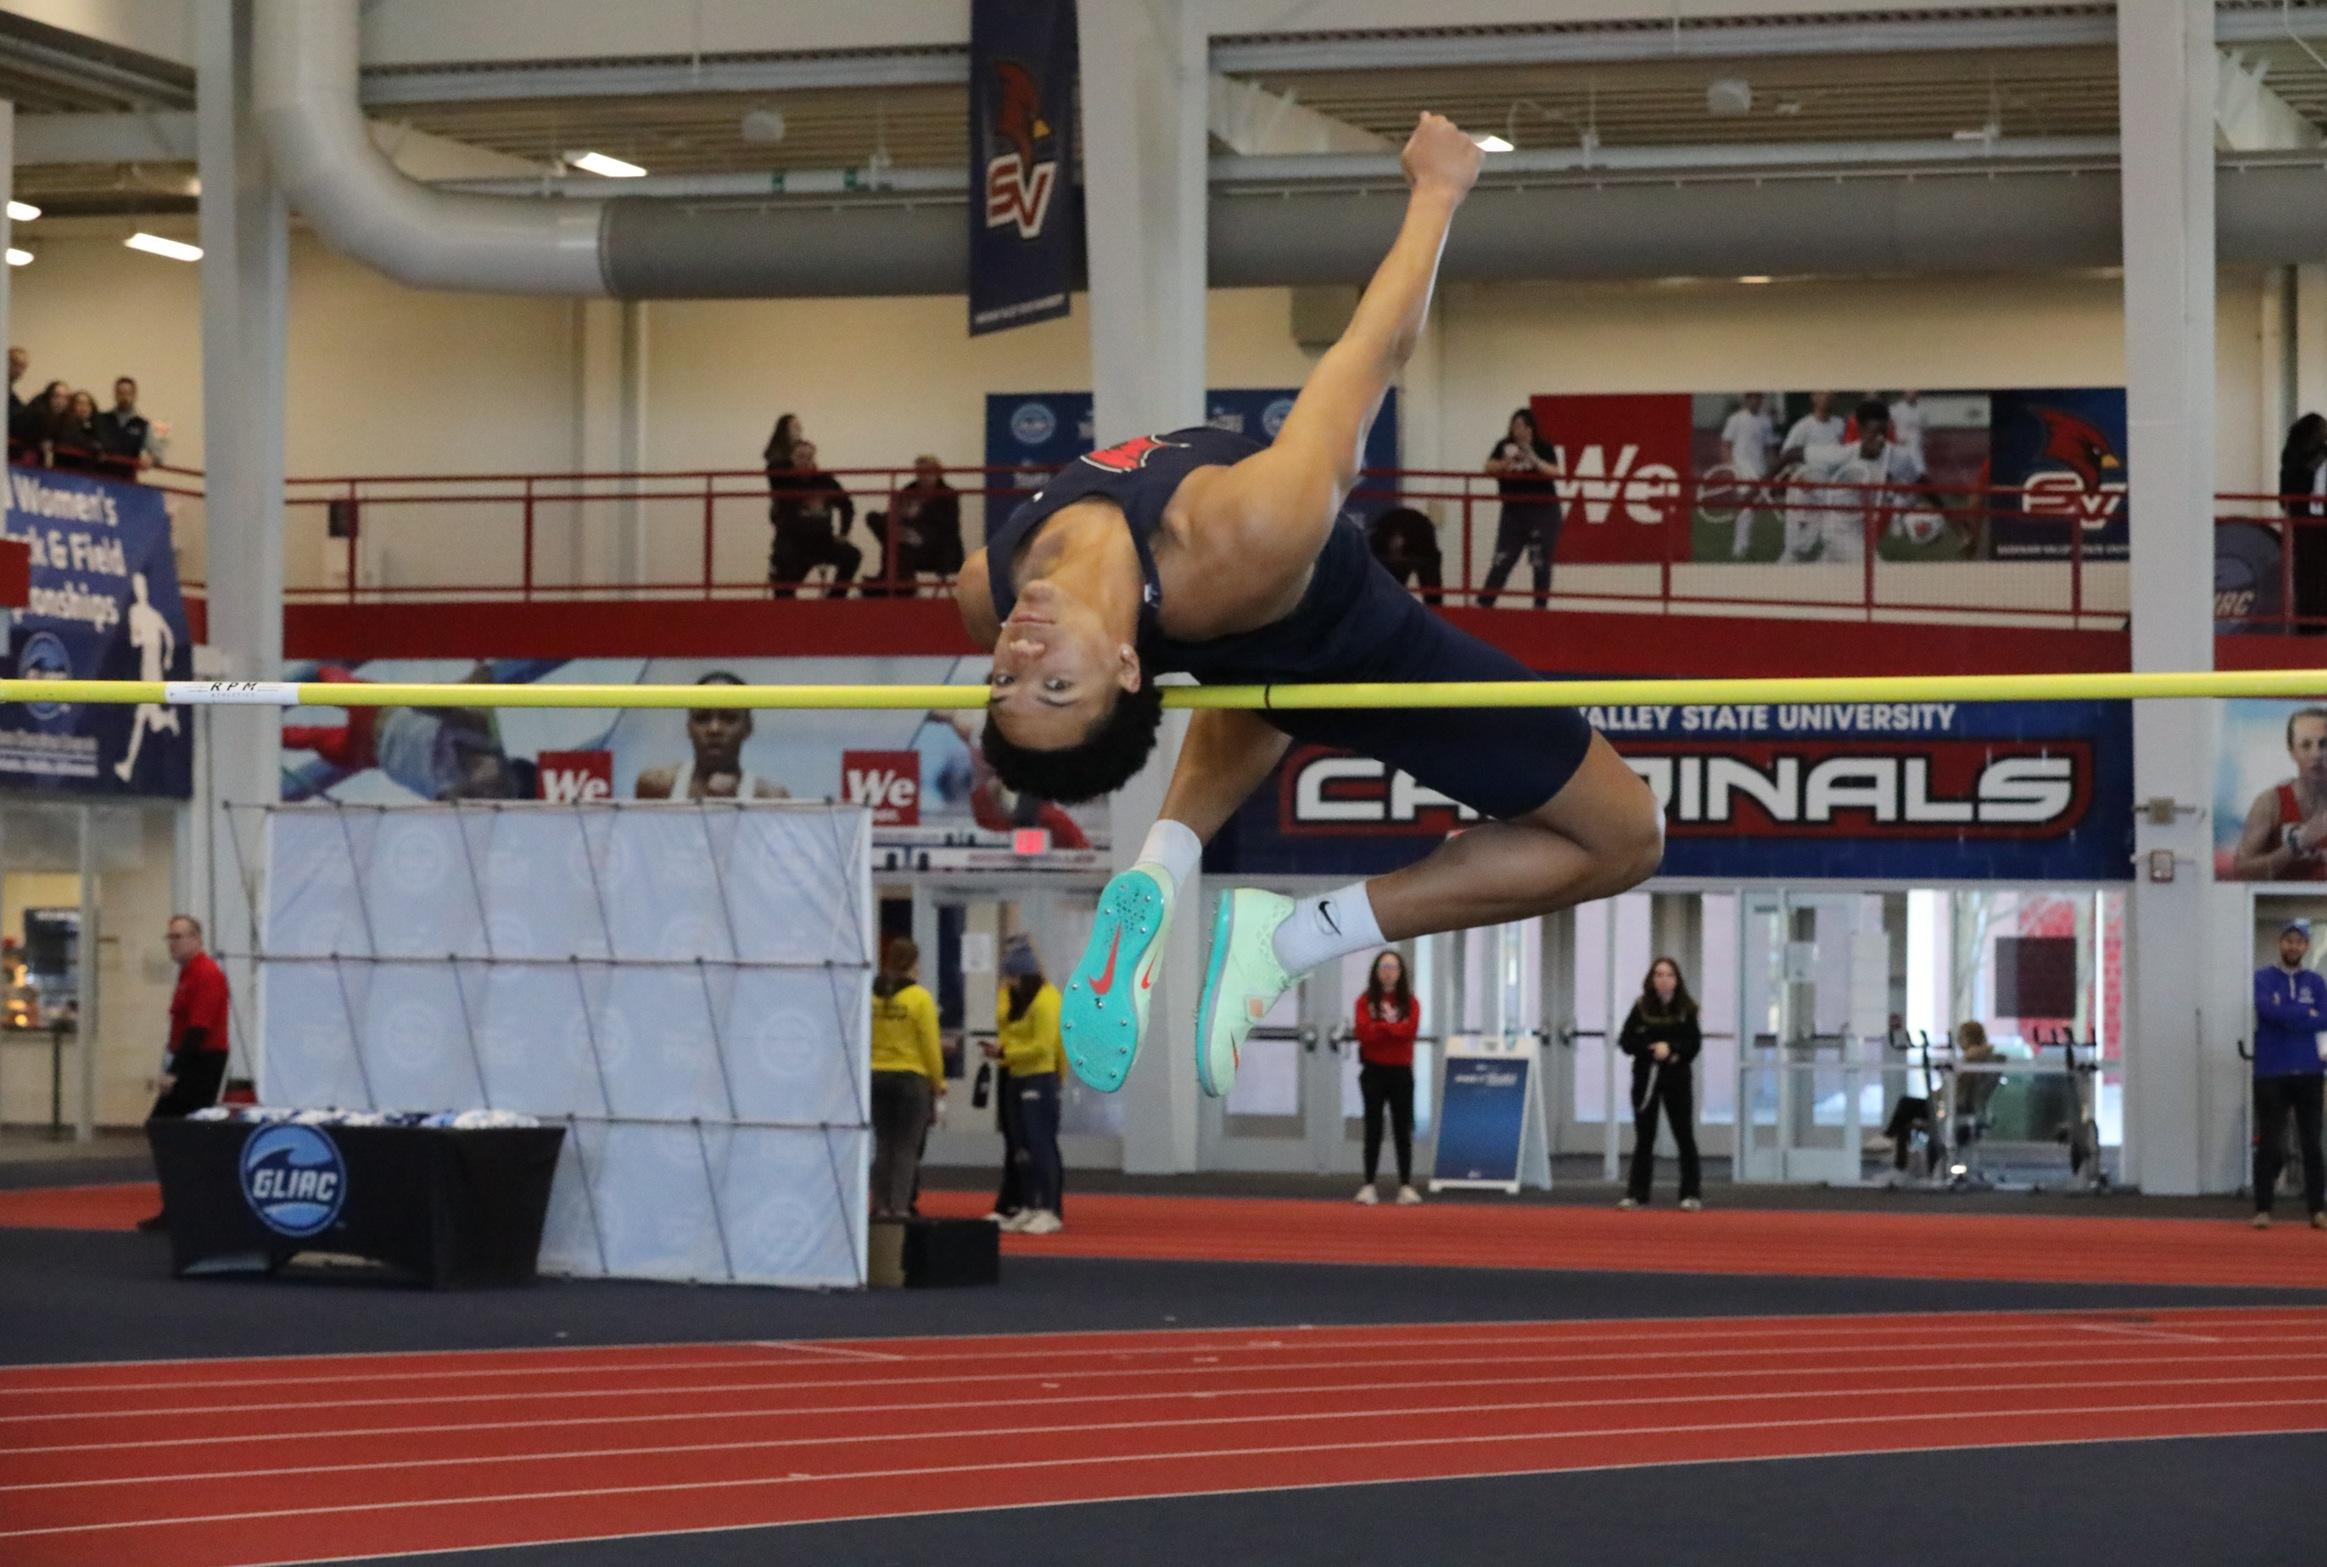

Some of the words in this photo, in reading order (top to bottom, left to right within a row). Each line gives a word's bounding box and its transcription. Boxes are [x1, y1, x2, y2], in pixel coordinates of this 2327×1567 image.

[985, 152, 1057, 240] SV
[12, 474, 119, 527] Women's
[1552, 444, 1682, 524] We
[68, 531, 127, 578] Field
[1578, 705, 1673, 731] ALLEY
[1680, 705, 1771, 731] STATE
[1778, 704, 1957, 731] UNIVERSITY
[542, 769, 609, 802] We
[846, 768, 916, 808] We
[1296, 756, 2072, 822] CAINALS
[252, 1168, 338, 1201] GLIAC
